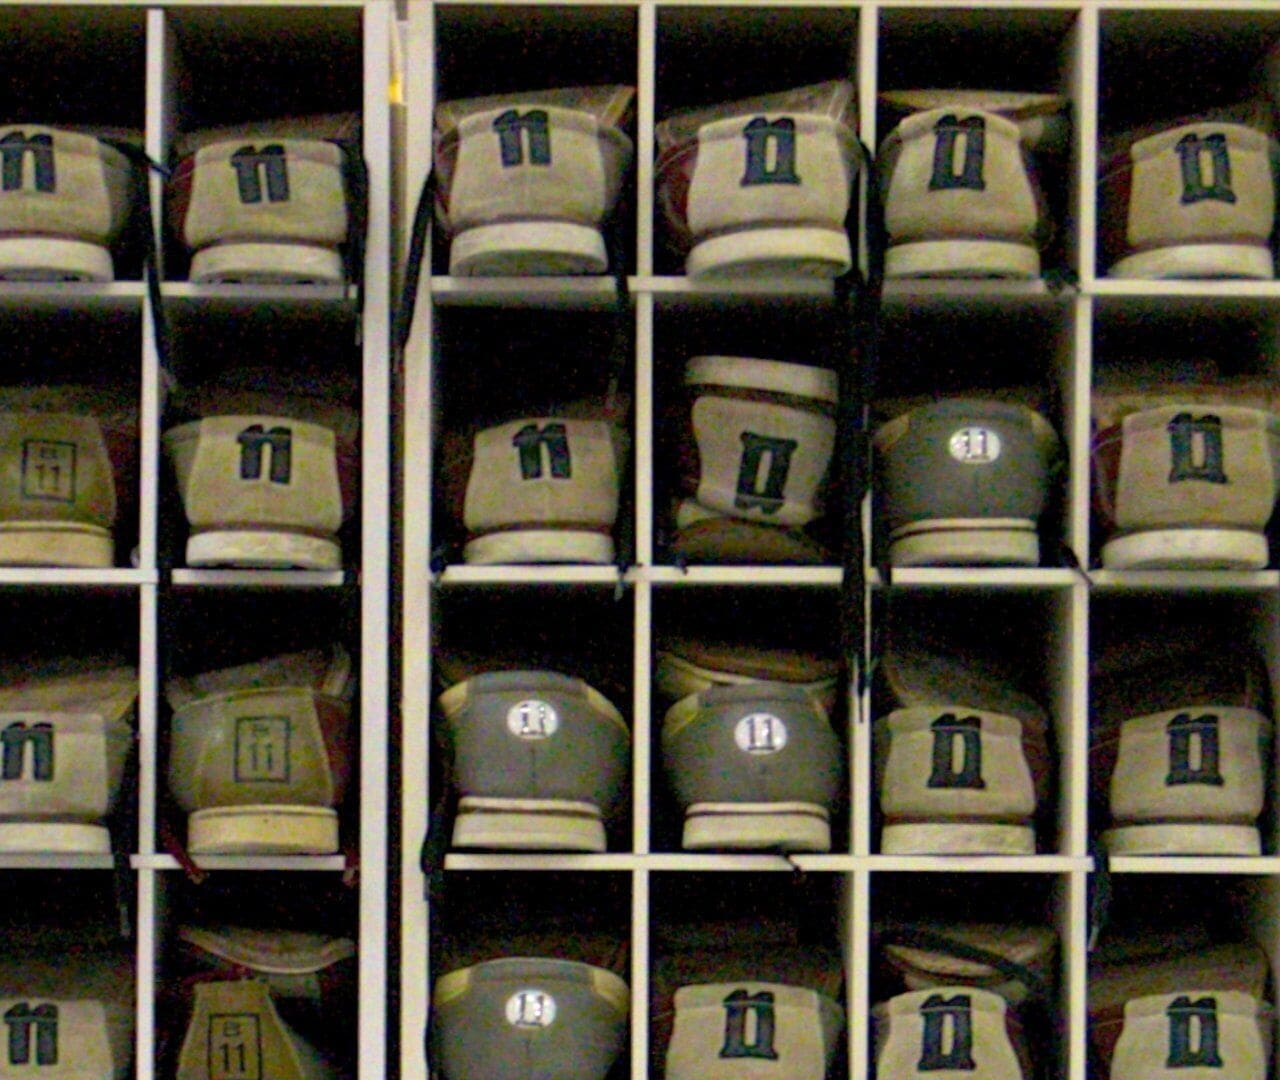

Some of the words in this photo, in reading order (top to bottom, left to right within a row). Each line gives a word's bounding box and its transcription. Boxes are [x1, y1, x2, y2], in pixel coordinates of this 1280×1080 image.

[231, 143, 290, 204] 11
[492, 109, 551, 167] 11
[741, 116, 801, 187] 11
[928, 114, 986, 192] 11
[1175, 132, 1237, 205] 11
[237, 424, 292, 484] 11
[512, 423, 571, 480] 11
[734, 431, 798, 515] 11
[1167, 412, 1229, 485] 11
[0, 721, 54, 782] 11
[247, 742, 274, 771] 11
[927, 713, 986, 790] 11
[1166, 713, 1224, 786] 11
[3, 1001, 58, 1065] 11
[221, 1043, 246, 1072] 11
[720, 988, 779, 1061] 11
[918, 994, 976, 1071] 11
[1166, 996, 1223, 1068] 11
